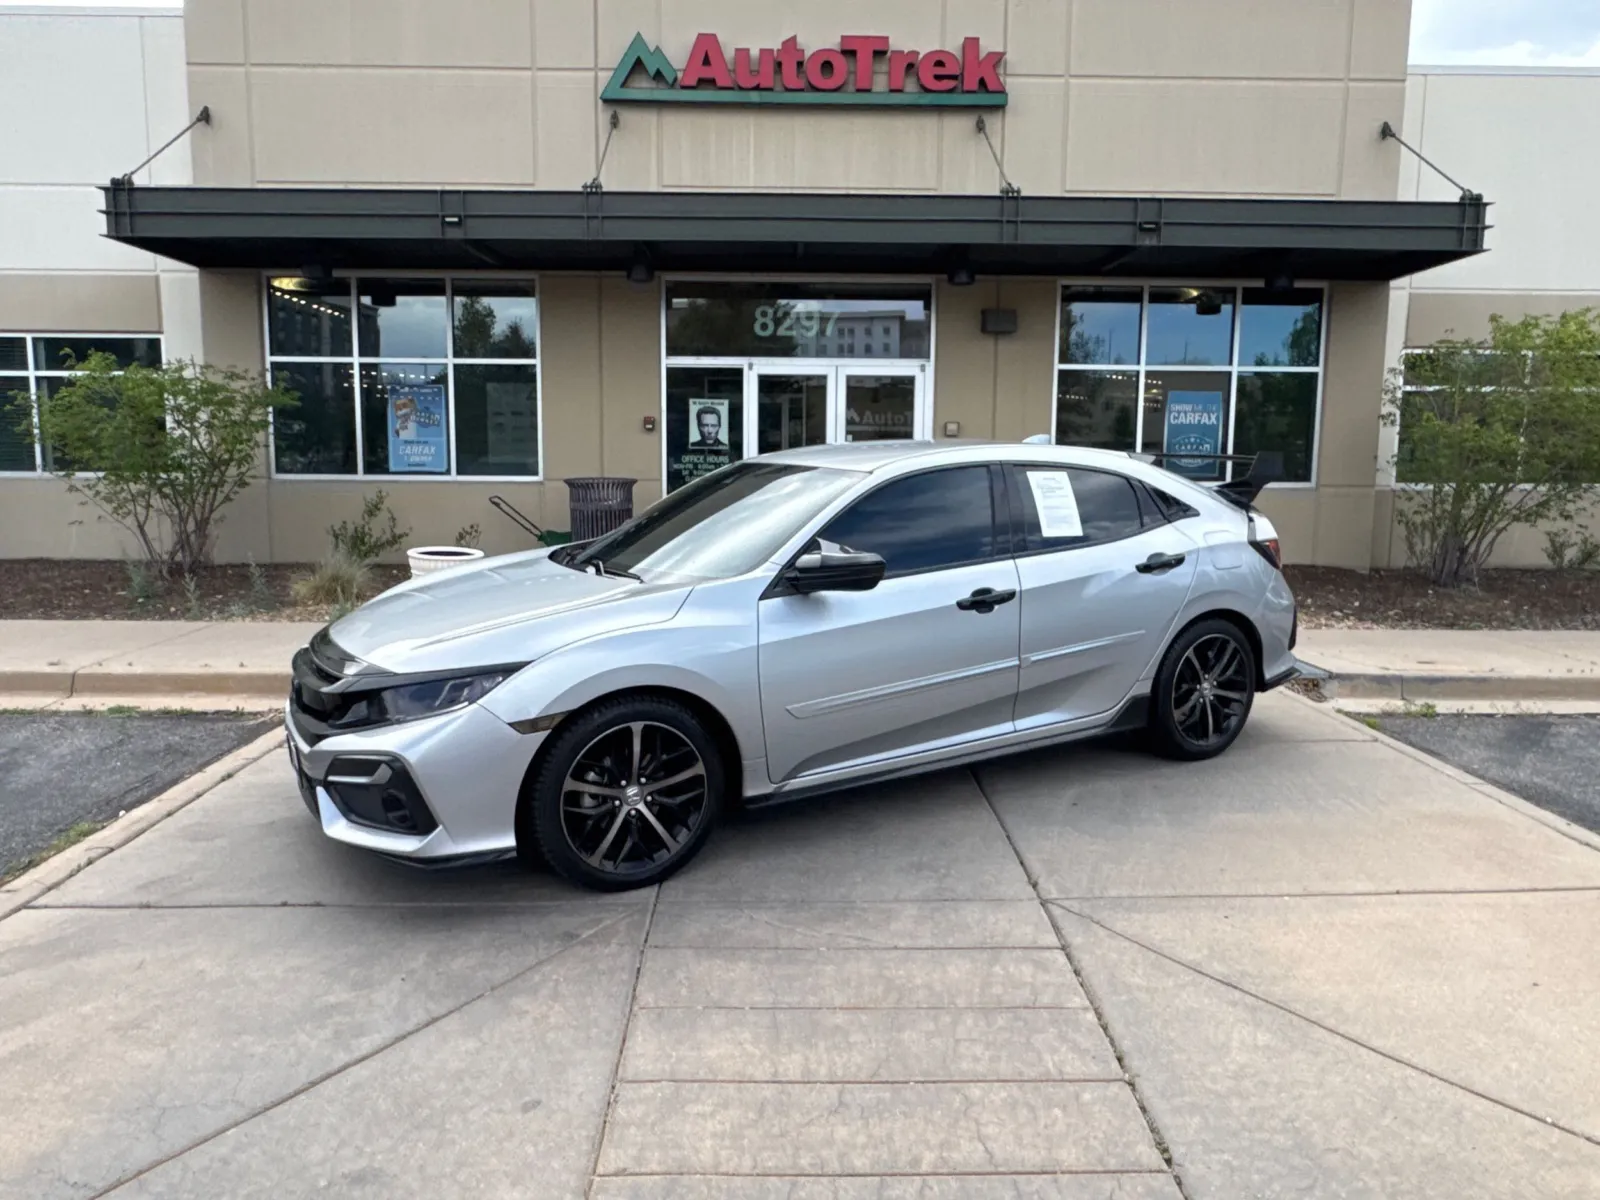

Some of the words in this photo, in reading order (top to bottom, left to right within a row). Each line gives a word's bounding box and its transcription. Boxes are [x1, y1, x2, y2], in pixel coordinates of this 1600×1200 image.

[680, 33, 1007, 93] AutoTrek
[753, 305, 839, 337] 8297
[1170, 412, 1217, 425] CARFAX
[399, 445, 436, 455] CARFAX
[681, 455, 704, 463] OFFICE
[706, 455, 729, 463] HOURS
